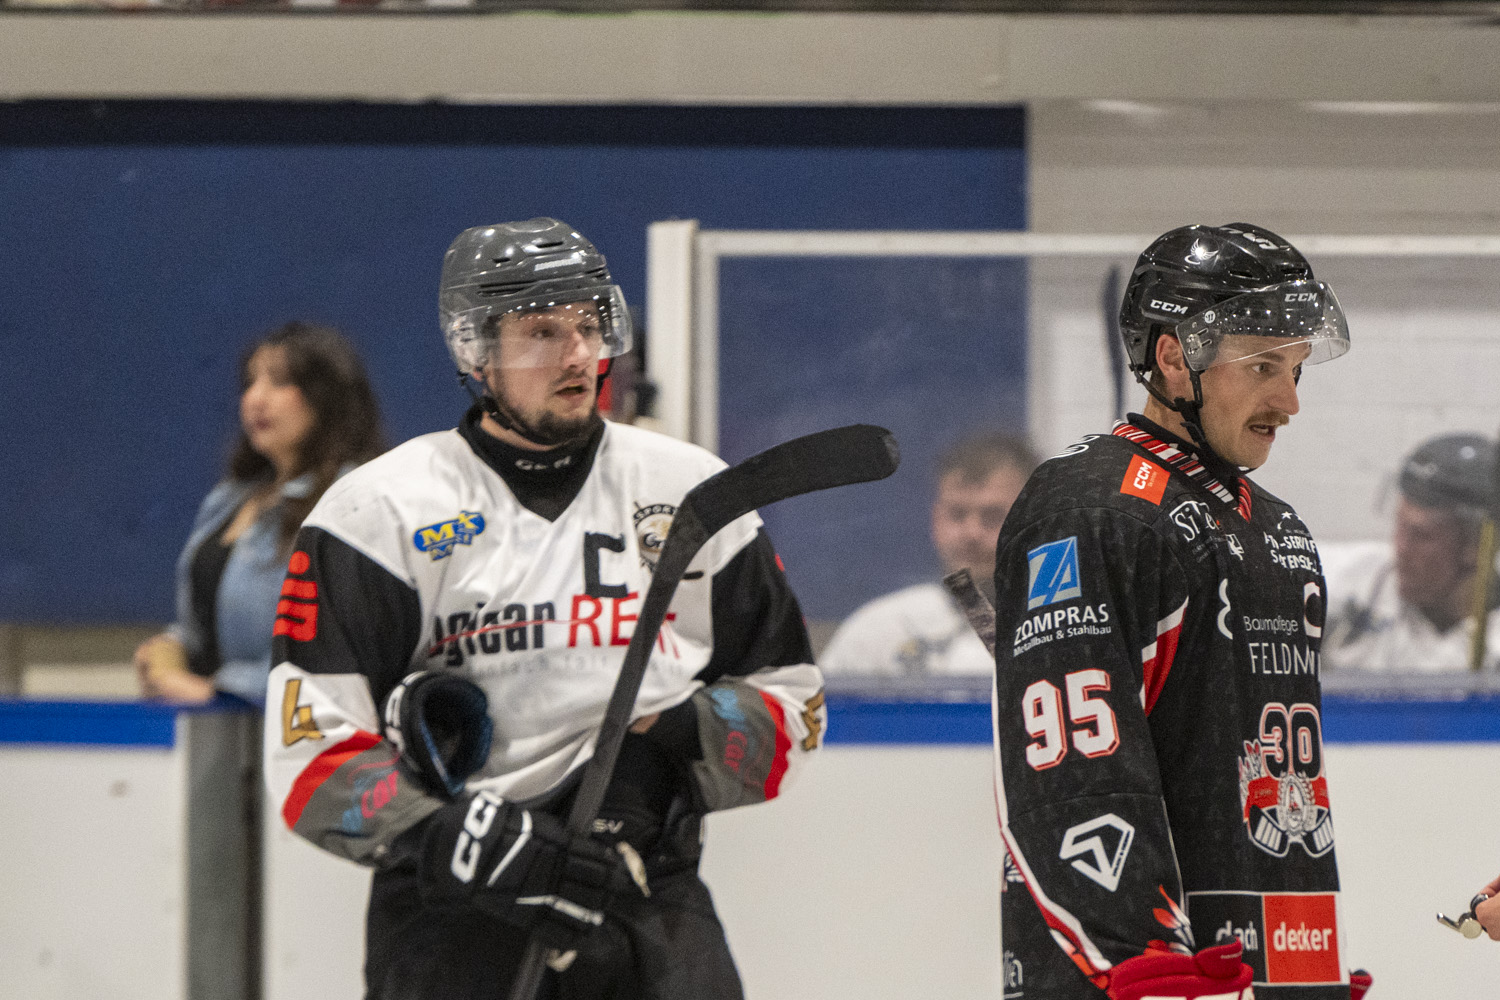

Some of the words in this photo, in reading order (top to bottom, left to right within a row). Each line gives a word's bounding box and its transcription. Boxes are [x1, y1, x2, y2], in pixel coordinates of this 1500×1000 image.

[1150, 299, 1189, 315] CCM
[1285, 292, 1318, 303] CCM
[1133, 461, 1153, 490] CCM
[583, 531, 628, 599] C
[1303, 581, 1322, 639] C
[1056, 629, 1065, 640] &
[1067, 624, 1112, 639] Stahlbau
[1022, 668, 1121, 772] 95
[1258, 702, 1327, 781] 30
[1273, 921, 1333, 952] decker
